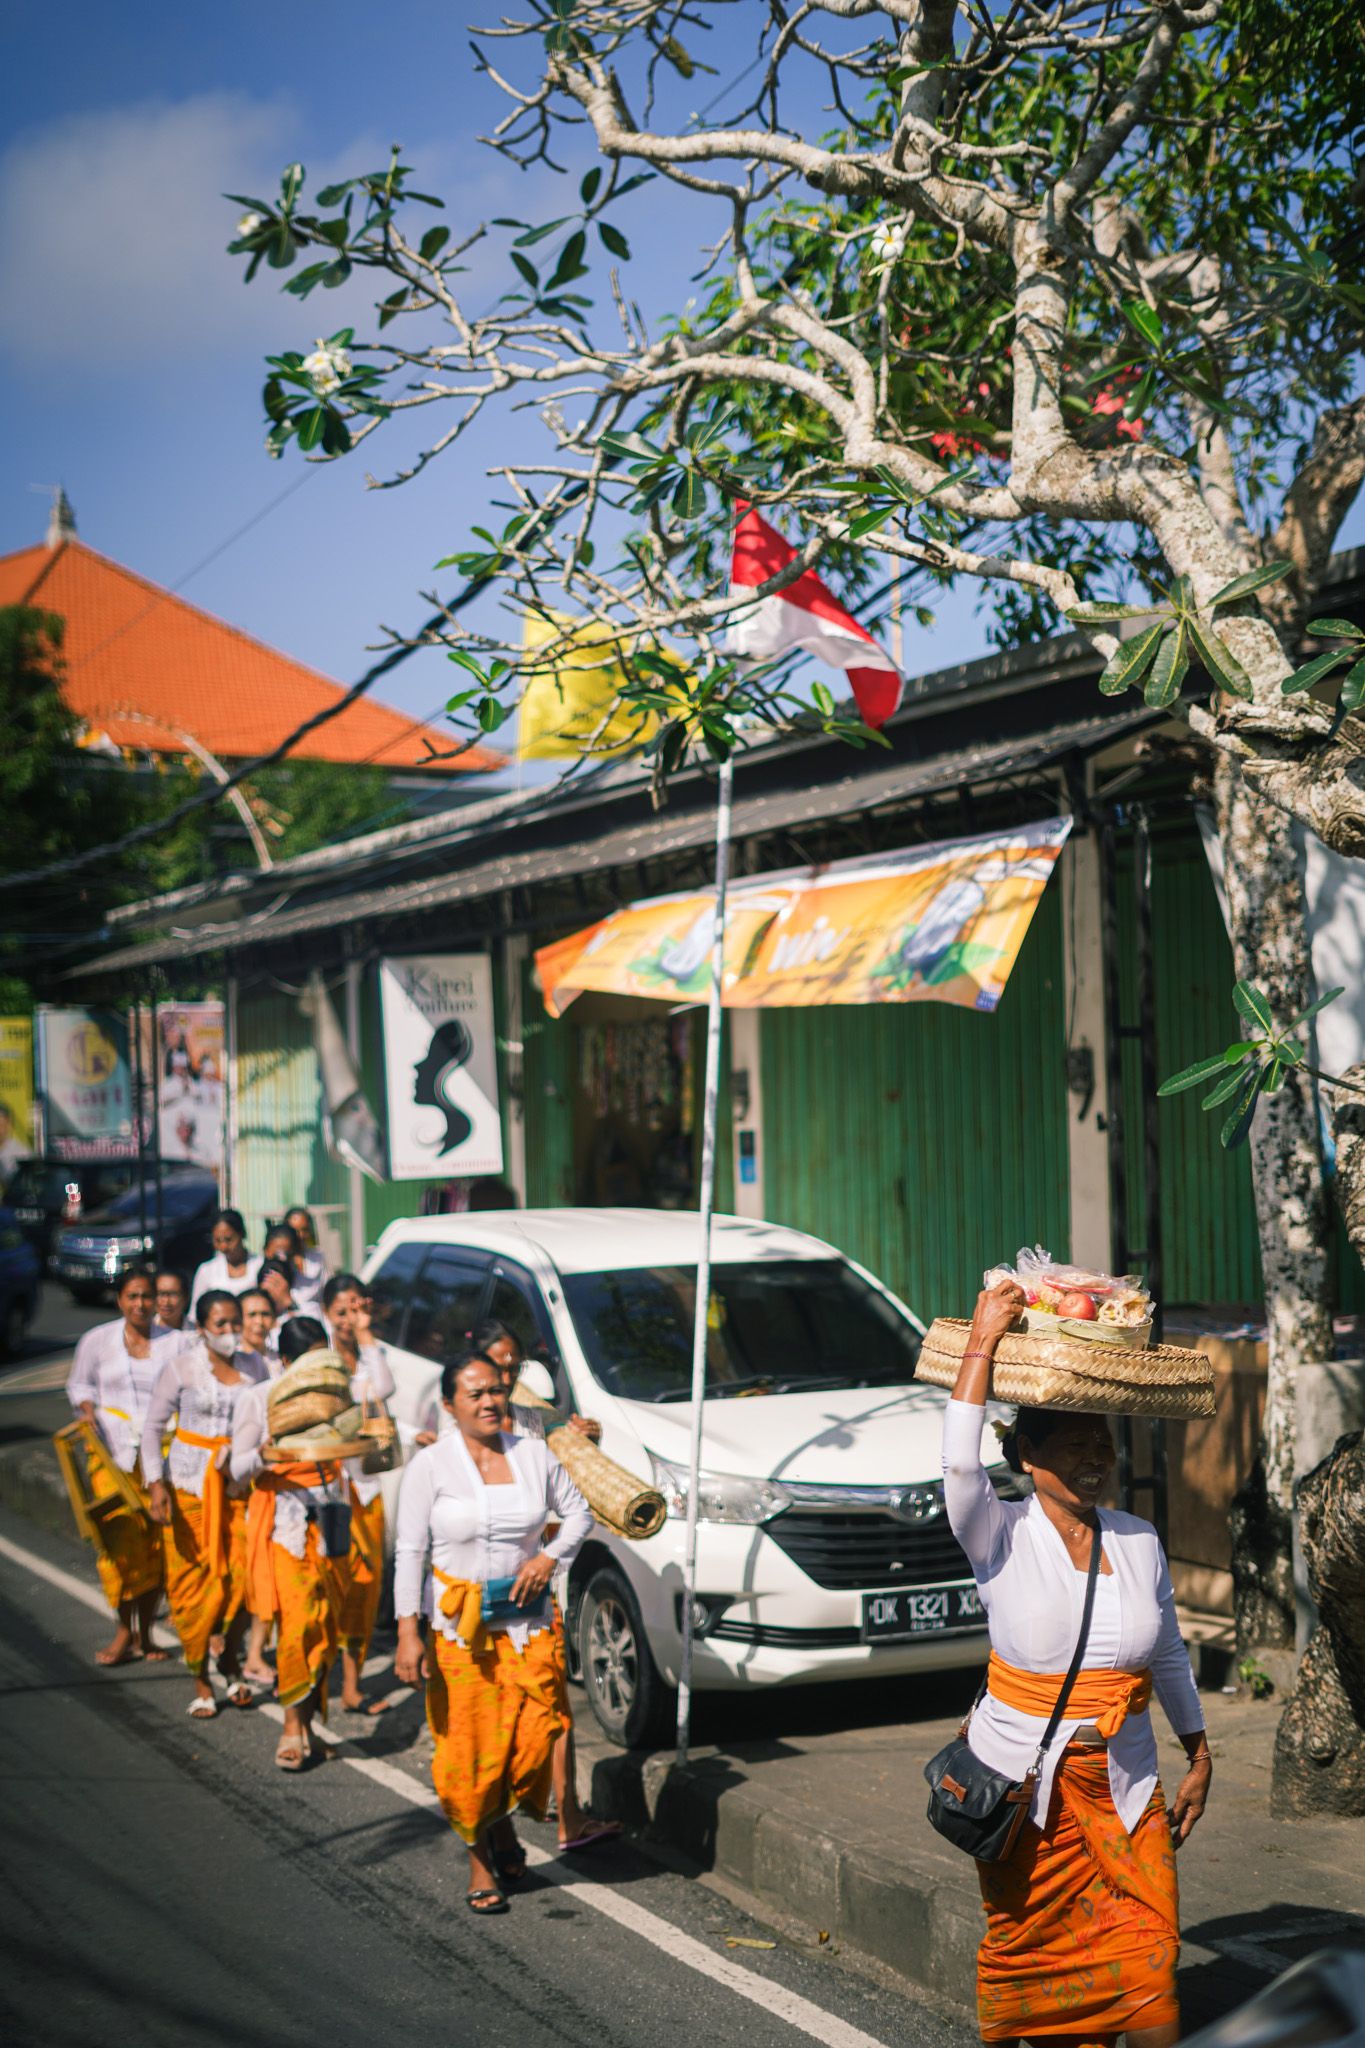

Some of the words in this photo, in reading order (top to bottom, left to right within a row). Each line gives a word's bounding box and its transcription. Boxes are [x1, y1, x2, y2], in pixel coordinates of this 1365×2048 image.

[406, 996, 478, 1014] oiffure
[873, 1597, 898, 1625] DK
[906, 1592, 949, 1620] 1321
